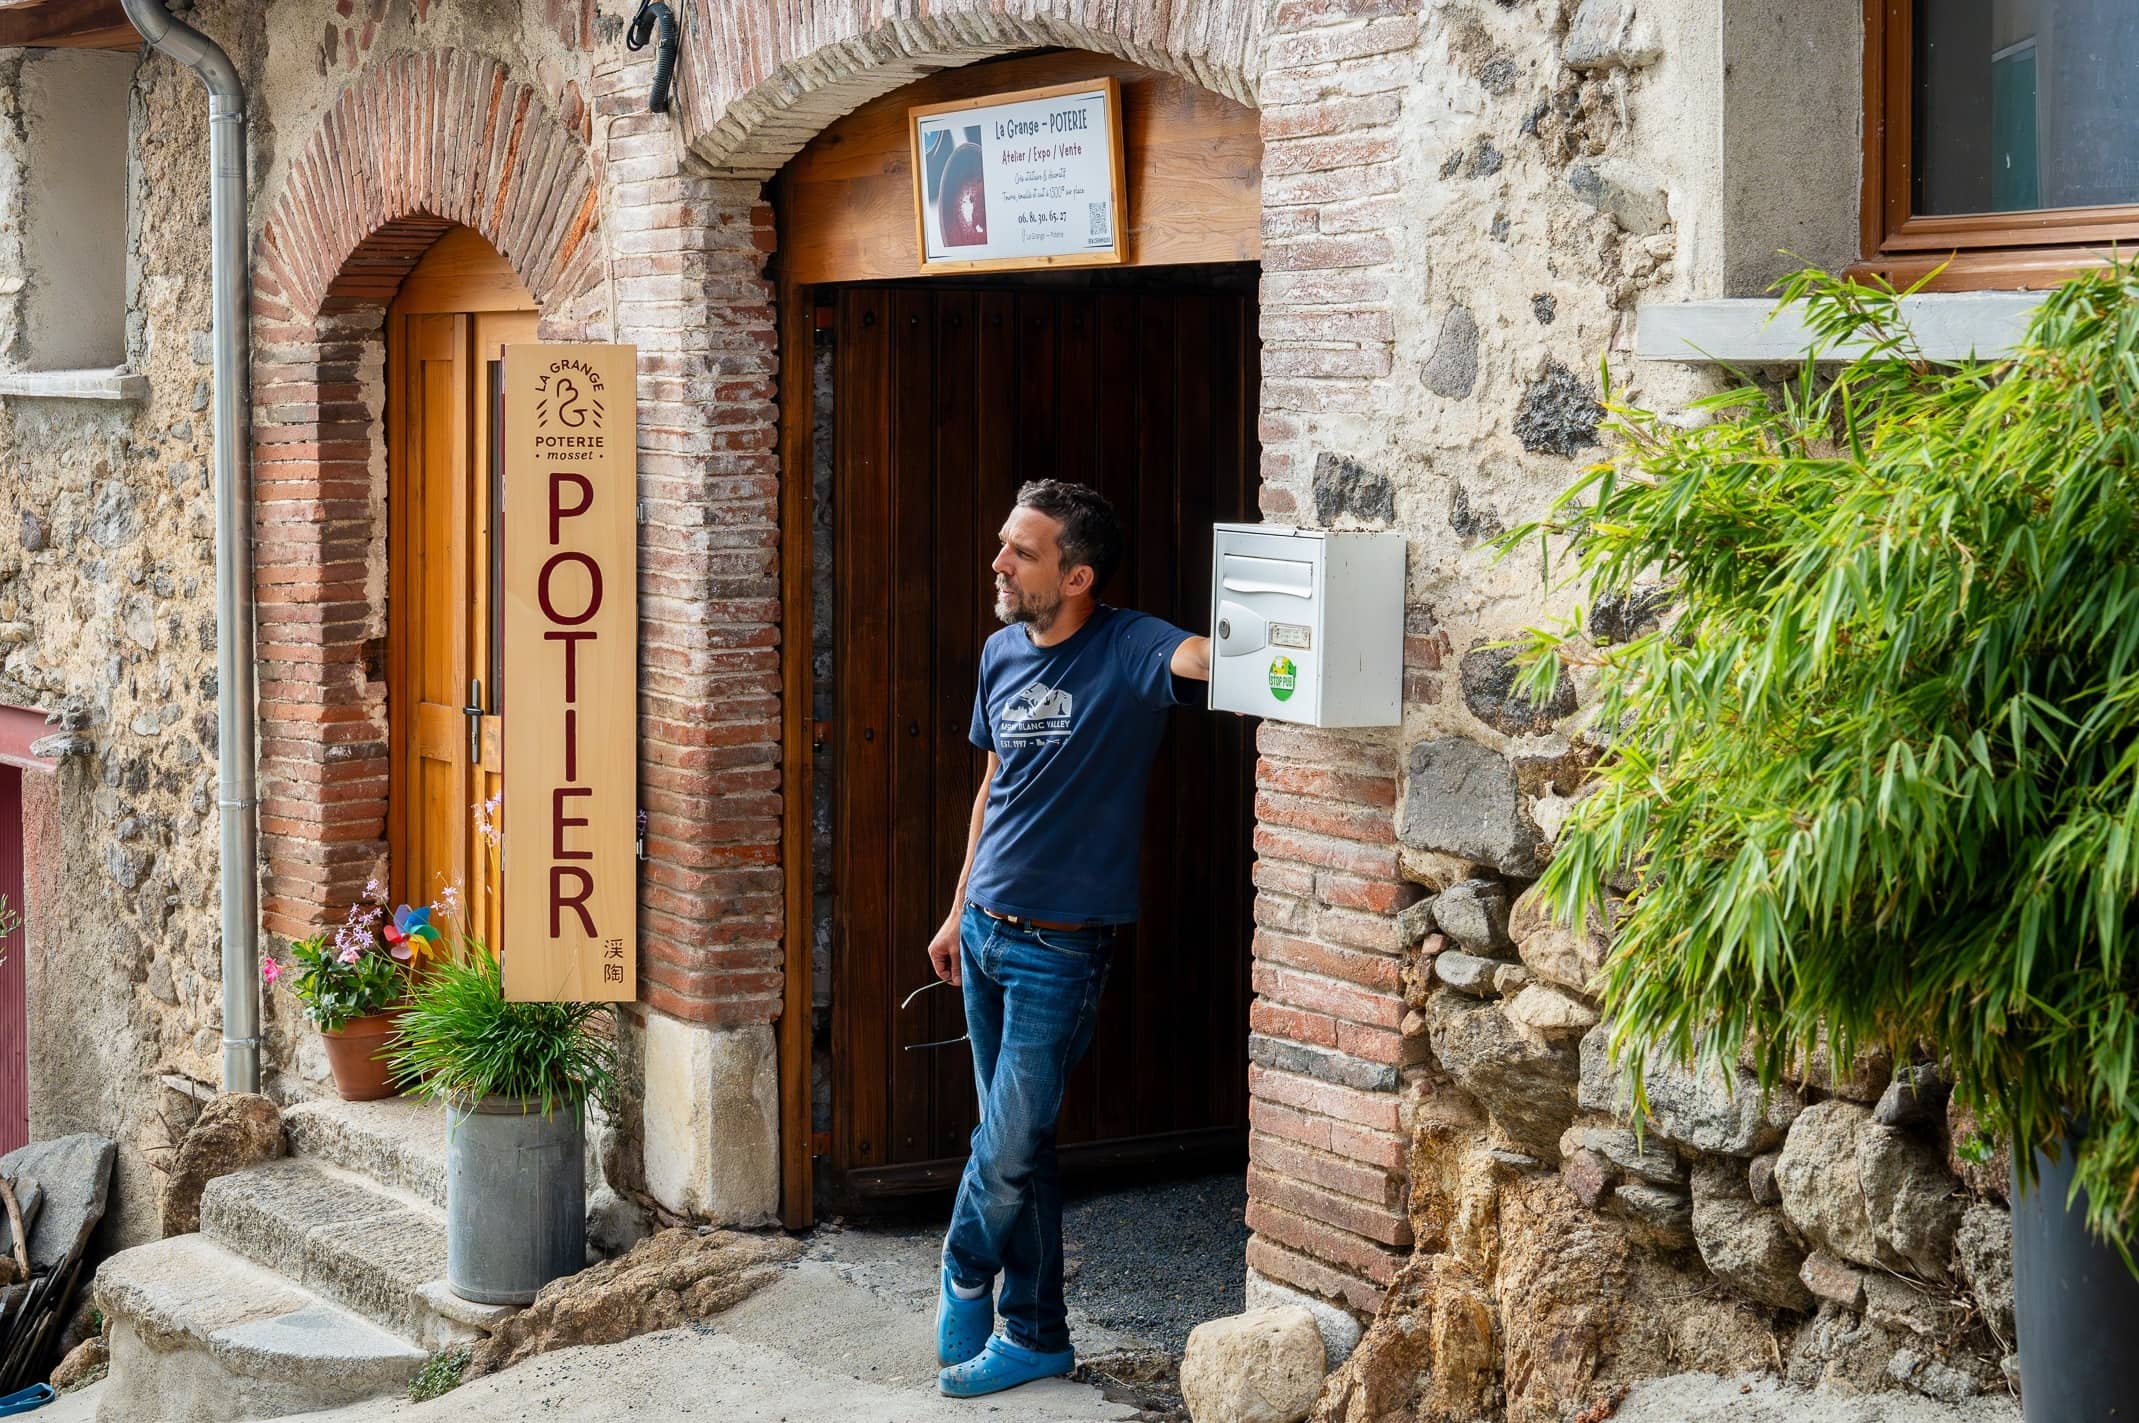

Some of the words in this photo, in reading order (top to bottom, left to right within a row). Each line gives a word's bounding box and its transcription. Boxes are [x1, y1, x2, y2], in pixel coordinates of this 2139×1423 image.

[995, 120, 1004, 140] La
[1007, 119, 1039, 138] Grange
[1050, 108, 1087, 134] POTERIE
[1002, 150, 1025, 166] Atelier
[1033, 146, 1050, 163] Expo
[1060, 143, 1082, 158] Vente
[535, 375, 551, 392] LA
[550, 359, 605, 392] GRANGE
[535, 436, 604, 447] POTERIE
[547, 450, 593, 460] mosset
[1270, 675, 1282, 687] STOP
[1283, 676, 1293, 687] PUB
[537, 472, 604, 939] POTIER
[1047, 720, 1070, 729] VALLEY
